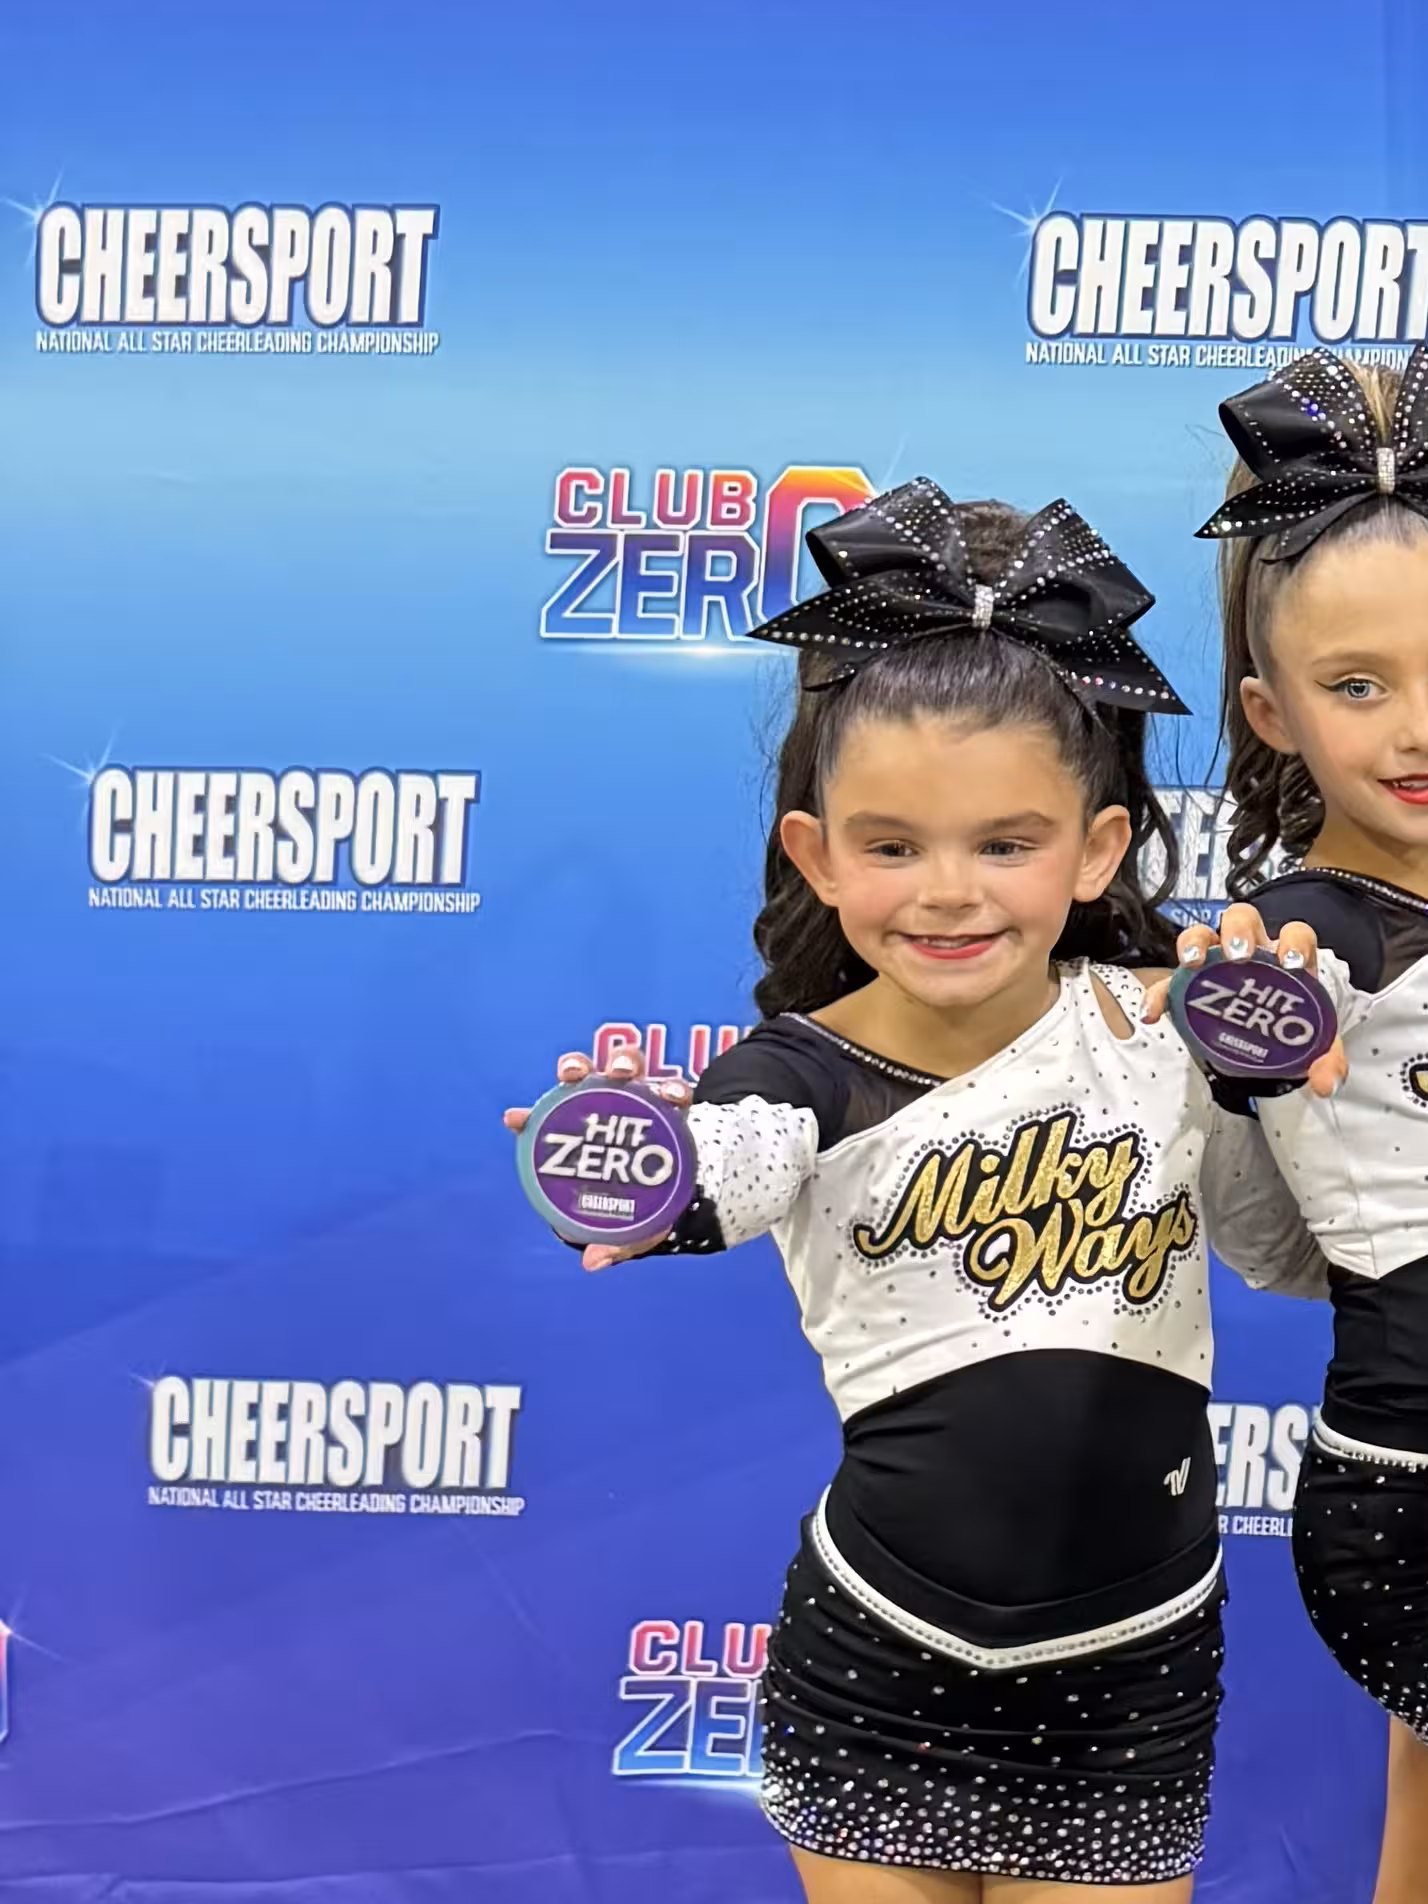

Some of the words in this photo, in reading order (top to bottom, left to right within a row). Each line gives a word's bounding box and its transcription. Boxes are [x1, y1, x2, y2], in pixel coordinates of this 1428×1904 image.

[38, 203, 438, 326] CHEERSPORT
[36, 329, 112, 354] NATIONAL
[118, 330, 147, 354] ALL
[152, 330, 192, 354] STAR
[197, 331, 312, 355] CHEERLEADING
[318, 331, 440, 356] CHAMPIONSHIP
[1026, 342, 1105, 366] NATIONAL
[1112, 343, 1143, 367] ALL
[1148, 344, 1191, 368] STAR
[553, 466, 758, 531] CLUB
[91, 766, 480, 885] CHEERSPORT
[88, 887, 162, 909] NATIONAL
[167, 888, 195, 910] ALL
[201, 888, 240, 911] STAR
[244, 889, 356, 912] CHEERLEADING
[361, 891, 481, 914] CHAMPIONSHIP
[1187, 979, 1315, 1046] ZERO
[1237, 978, 1305, 1014] HIT
[584, 1112, 653, 1146] HIT
[537, 1132, 674, 1187] ZERO
[854, 1113, 1141, 1257] Milky
[967, 1196, 1195, 1308] Ways
[151, 1375, 521, 1489] CHEERSPORT
[148, 1486, 219, 1507] NATIONAL
[222, 1489, 249, 1510] ALL
[253, 1491, 292, 1512] STAR
[295, 1492, 406, 1514] CHEERLEADING
[409, 1494, 526, 1517] CHAMPIONSHIP
[629, 1619, 772, 1679] CLU
